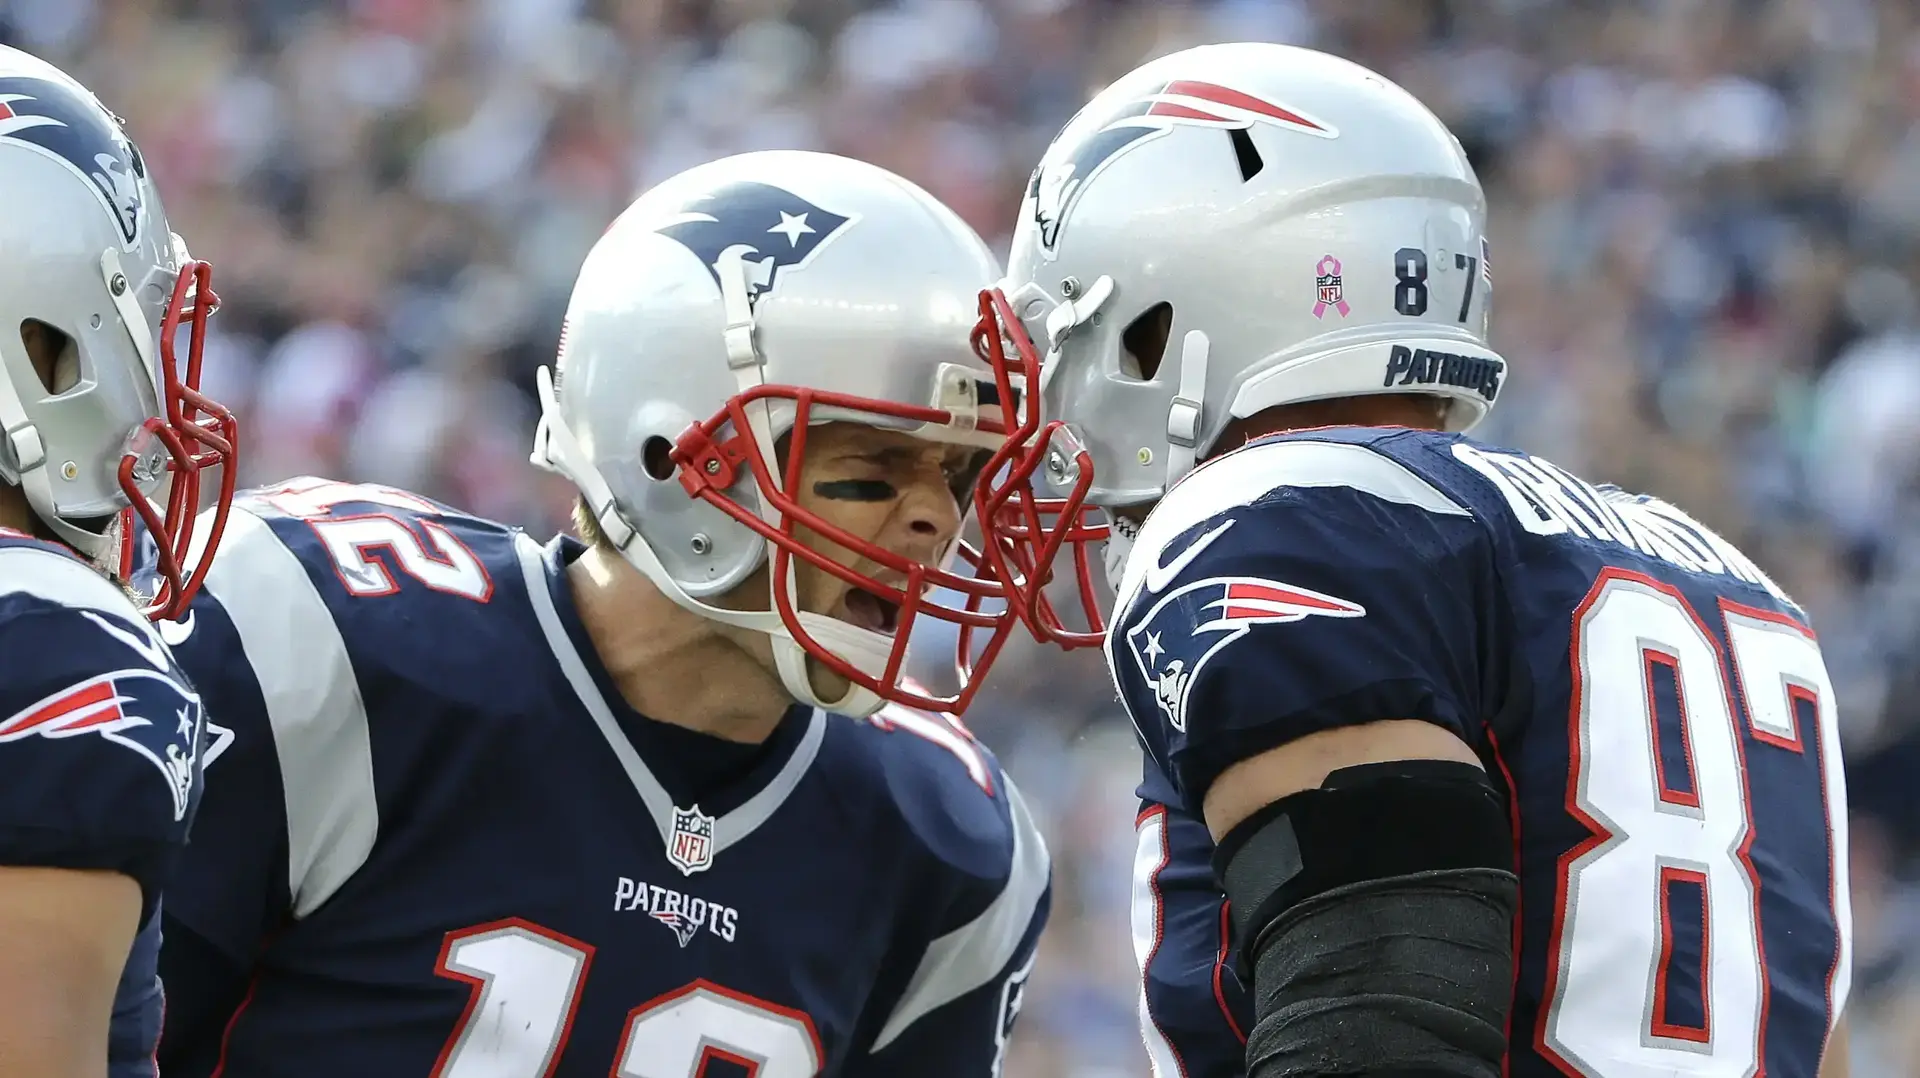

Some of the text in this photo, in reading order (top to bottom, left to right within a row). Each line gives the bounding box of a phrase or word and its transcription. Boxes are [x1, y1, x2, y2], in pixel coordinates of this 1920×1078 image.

[1320, 287, 1342, 301] NFL
[1383, 344, 1504, 401] PATRIOTS
[674, 833, 707, 863] NFL
[1532, 566, 1852, 1078] 87
[614, 877, 738, 943] PATRIOTS
